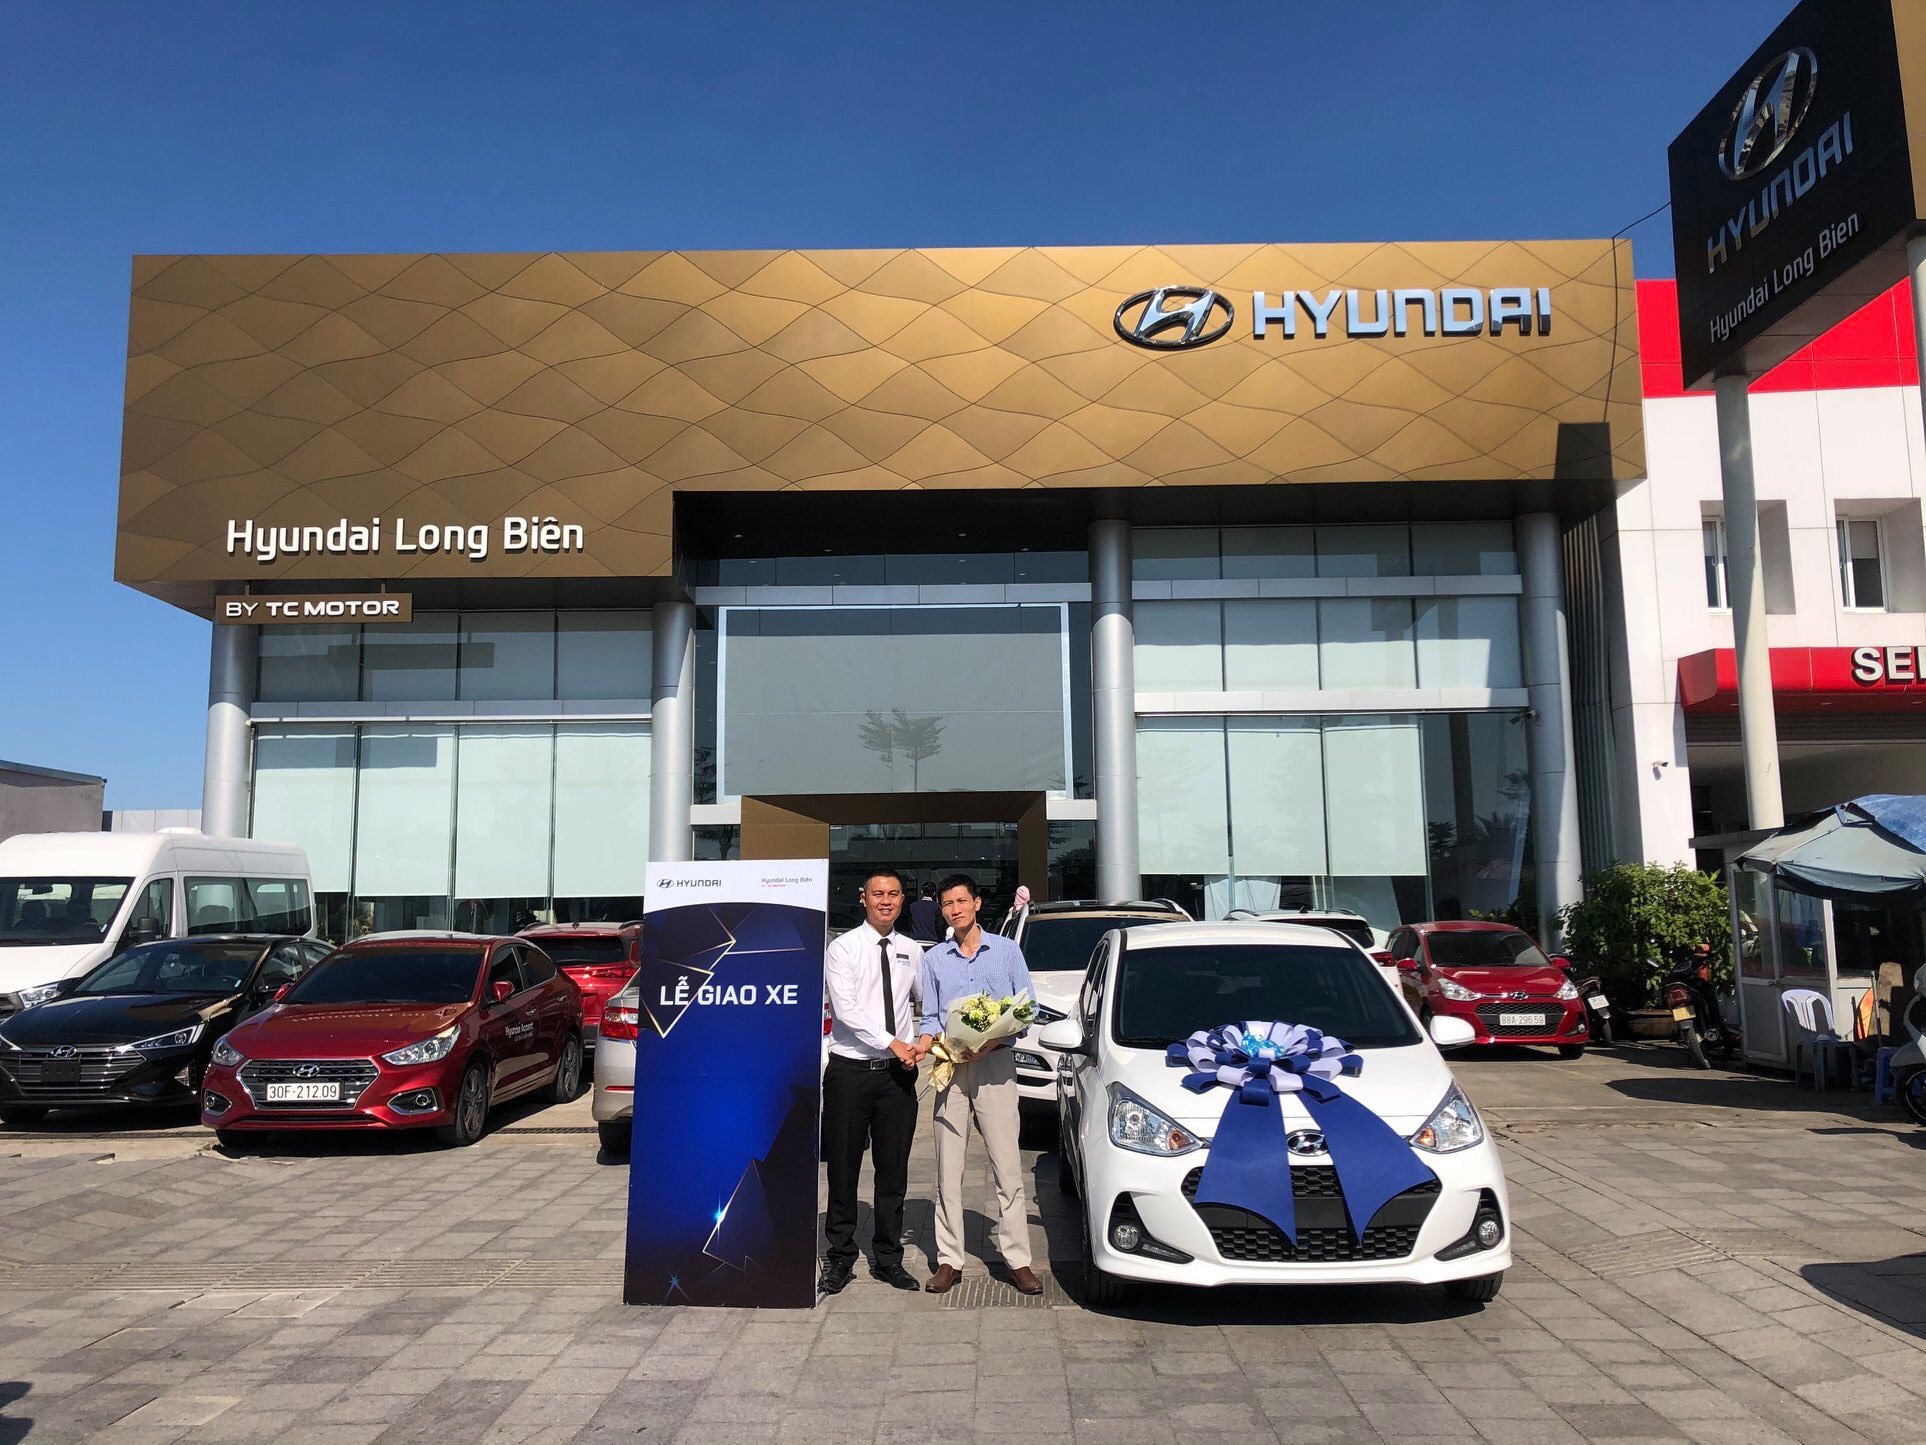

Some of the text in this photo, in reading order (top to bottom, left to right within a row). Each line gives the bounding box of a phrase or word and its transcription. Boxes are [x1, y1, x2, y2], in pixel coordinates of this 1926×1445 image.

[1707, 111, 1853, 274] HYUNDAI
[1710, 213, 1859, 343] Hyundai Long Bien
[1253, 288, 1551, 338] HYUNDAI
[227, 516, 584, 561] Hyundai Long Biên
[226, 600, 400, 617] BY TC MOTOR
[676, 879, 722, 887] HYUNDAI
[660, 975, 799, 1006] LỄ GIAO XE
[269, 1085, 337, 1099] 30F-212.09
